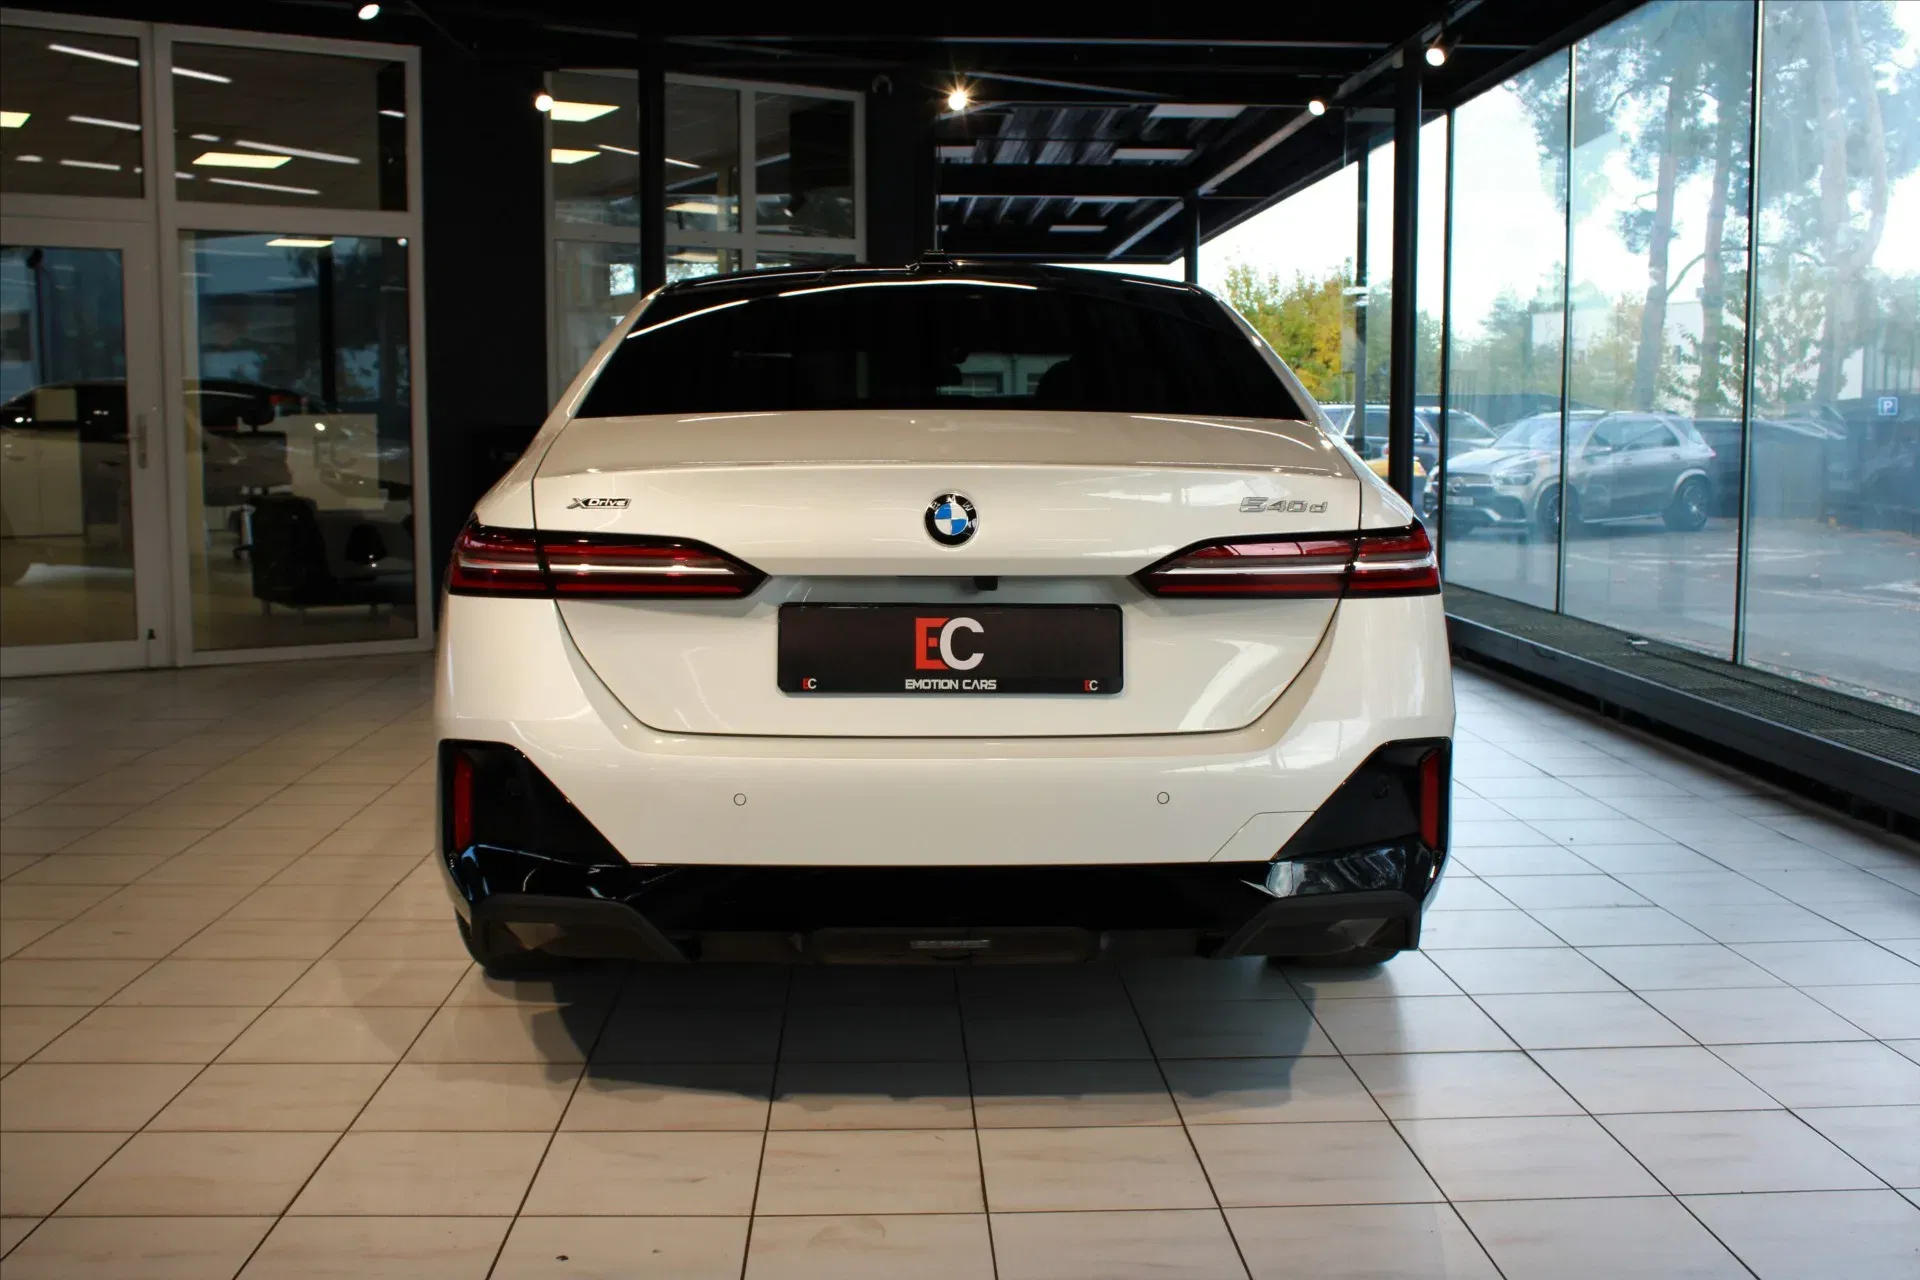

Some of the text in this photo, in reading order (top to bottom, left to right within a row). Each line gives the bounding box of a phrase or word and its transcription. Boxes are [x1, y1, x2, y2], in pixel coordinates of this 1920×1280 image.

[915, 616, 985, 671] EC
[905, 679, 997, 690] EMOTION CARS
